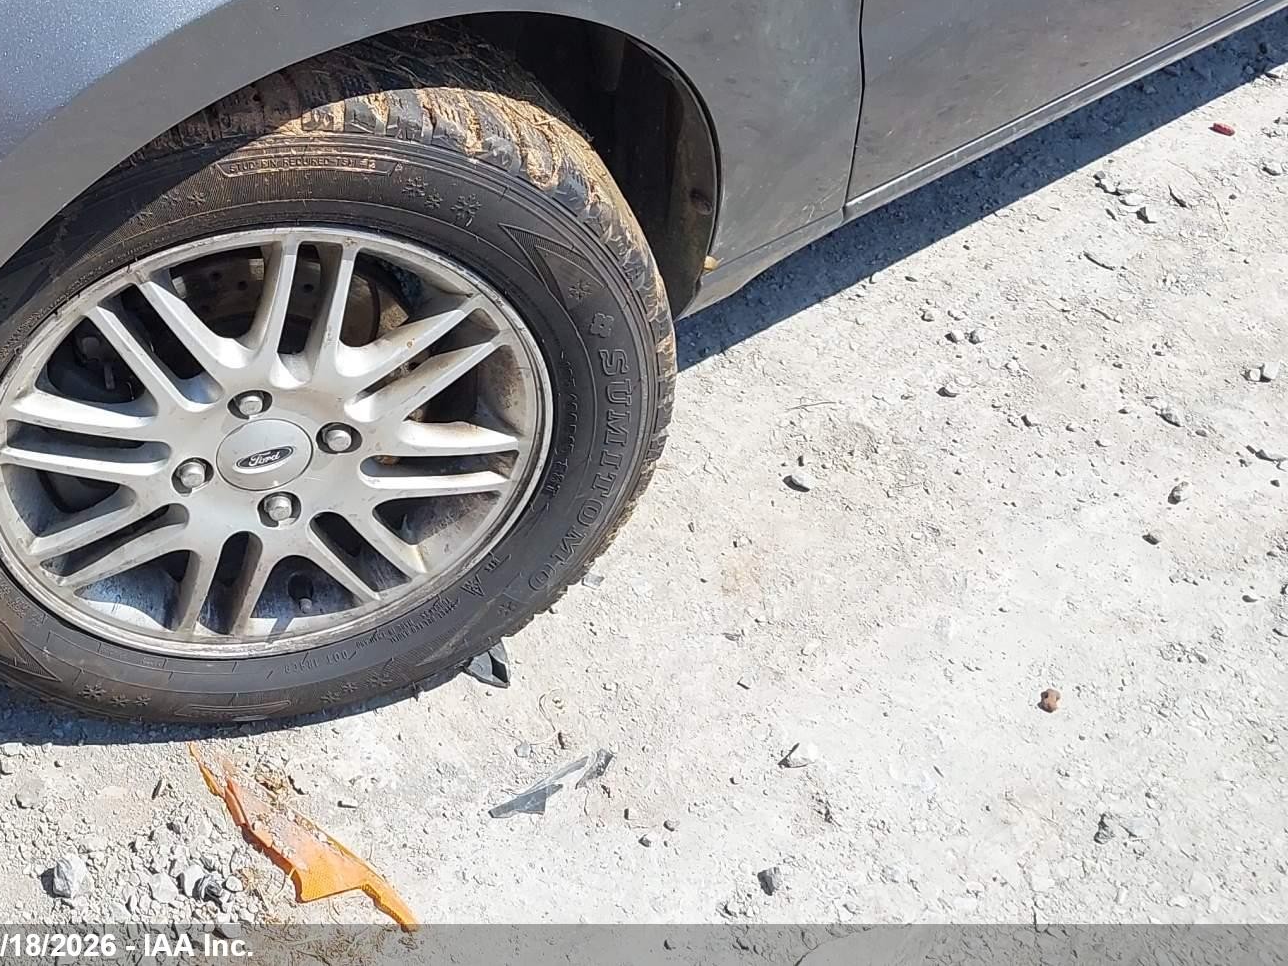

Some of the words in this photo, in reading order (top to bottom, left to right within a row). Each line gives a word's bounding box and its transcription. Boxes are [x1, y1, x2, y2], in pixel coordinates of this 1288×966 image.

[282, 157, 330, 168] REQUIRED
[248, 451, 281, 467] Ford
[528, 348, 633, 592] SUMITOMO
